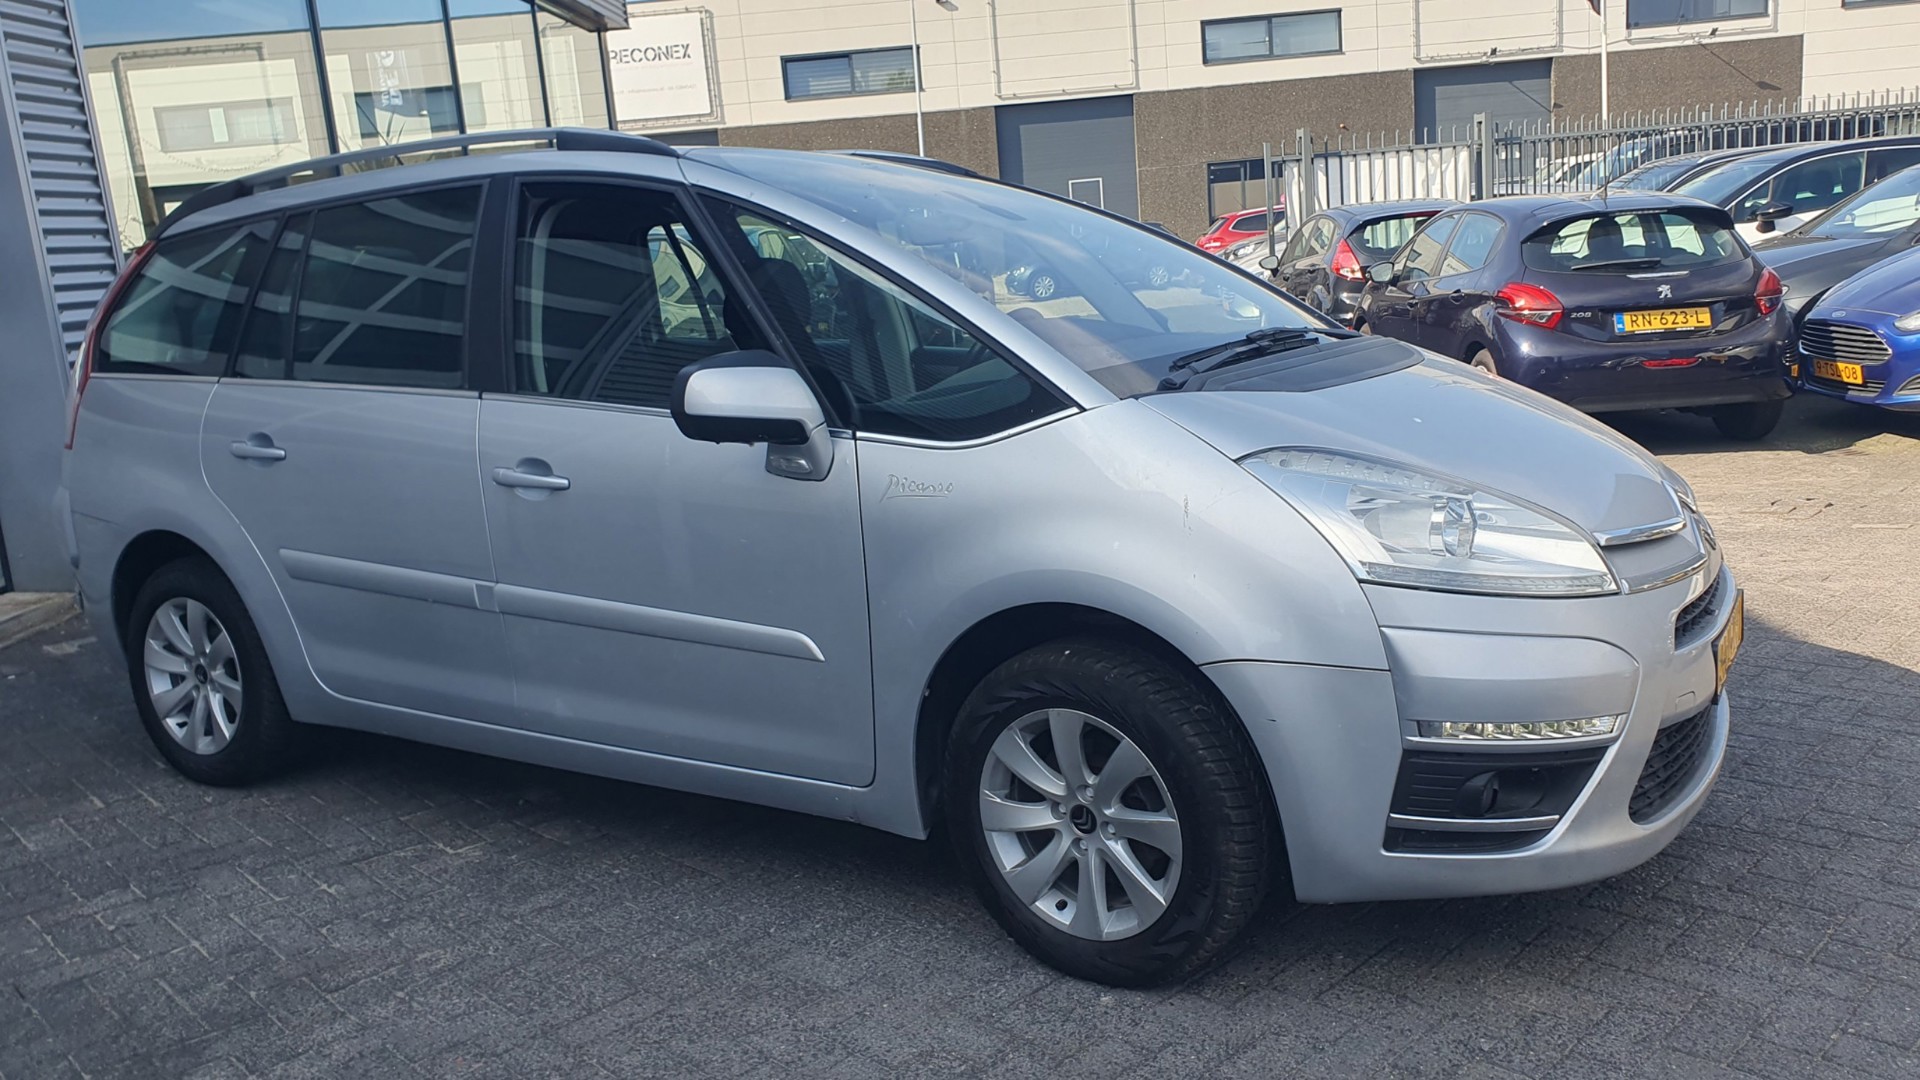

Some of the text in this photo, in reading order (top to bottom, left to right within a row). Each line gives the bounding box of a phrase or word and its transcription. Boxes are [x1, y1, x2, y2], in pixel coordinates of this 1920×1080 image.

[609, 43, 691, 64] RECONEX
[1629, 310, 1704, 328] RN-623-L
[1816, 360, 1858, 380] 9-TSL-08
[880, 473, 953, 503] Picasso
